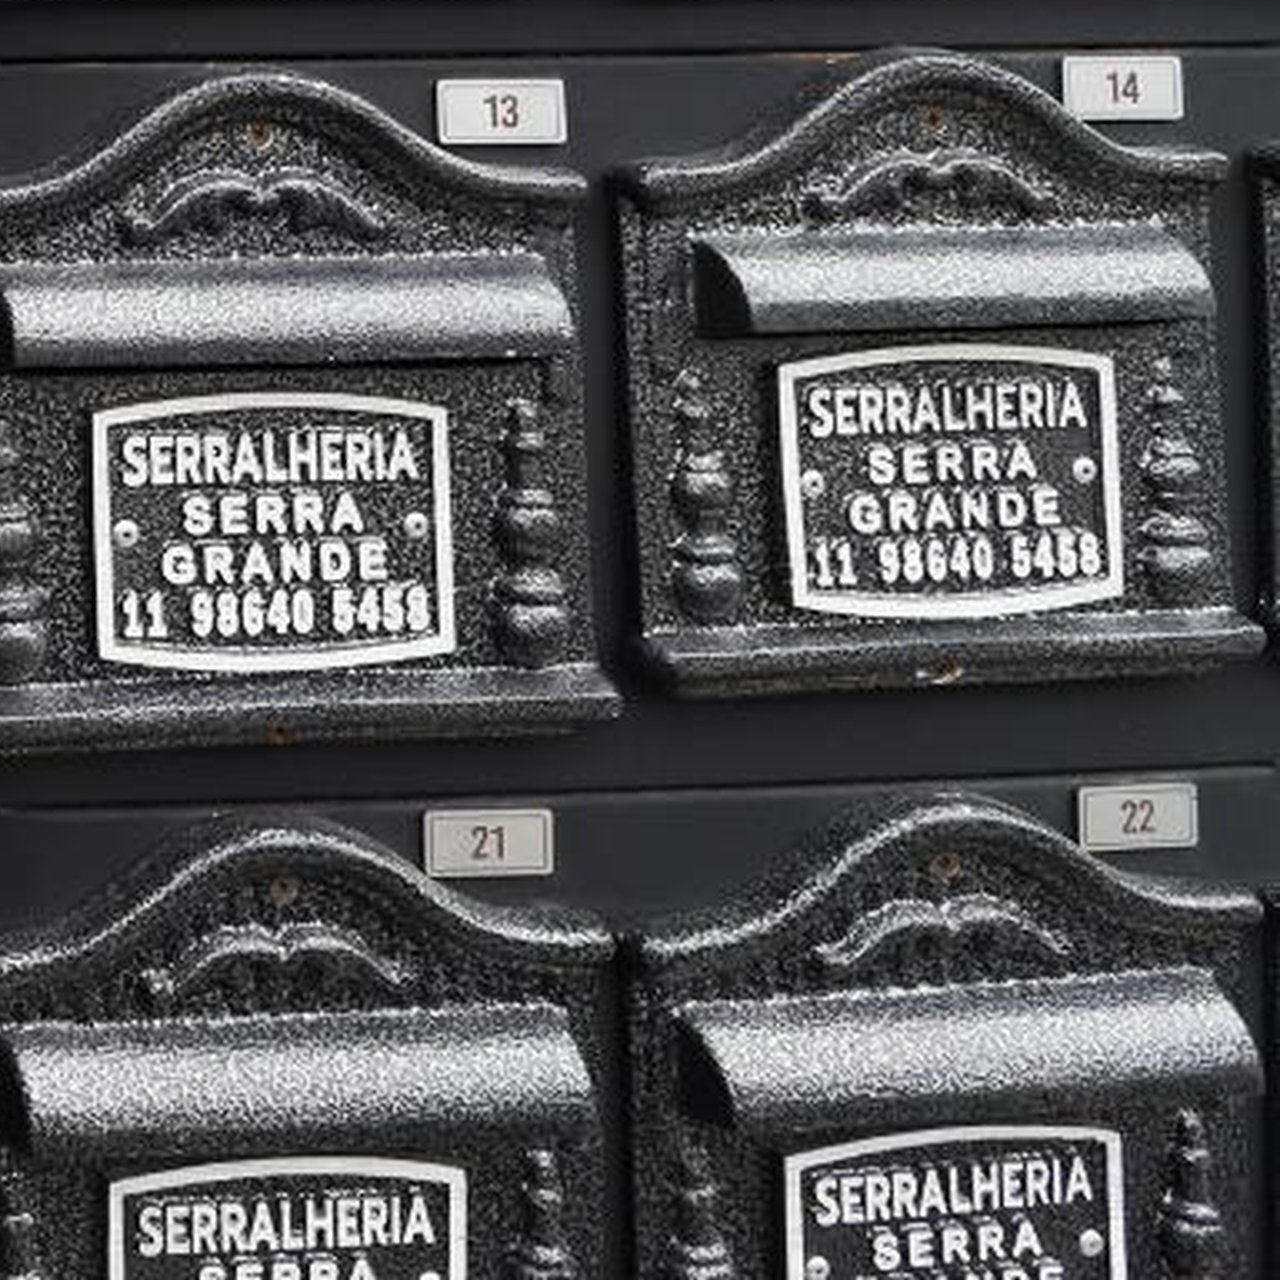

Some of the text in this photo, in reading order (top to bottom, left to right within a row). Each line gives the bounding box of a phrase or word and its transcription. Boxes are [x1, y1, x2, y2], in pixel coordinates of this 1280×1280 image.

[1106, 70, 1142, 105] 14
[483, 95, 519, 129] 13
[808, 382, 1087, 438] SERRALHERIA
[121, 431, 418, 487] SERRALHERIA
[868, 444, 1037, 485] SERRA
[183, 494, 364, 535] SERRA
[850, 489, 1062, 535] GRANDE
[162, 540, 387, 585] GRANDE
[815, 540, 857, 587] 11
[879, 537, 993, 583] 98640
[122, 589, 167, 637] 11
[192, 589, 314, 637] 98640
[1121, 799, 1157, 834] 22
[470, 826, 507, 860] 21
[815, 1156, 1093, 1227] SERRALHERIA
[140, 1196, 436, 1257] SERRALHERIA
[873, 1220, 1042, 1271] SERRA
